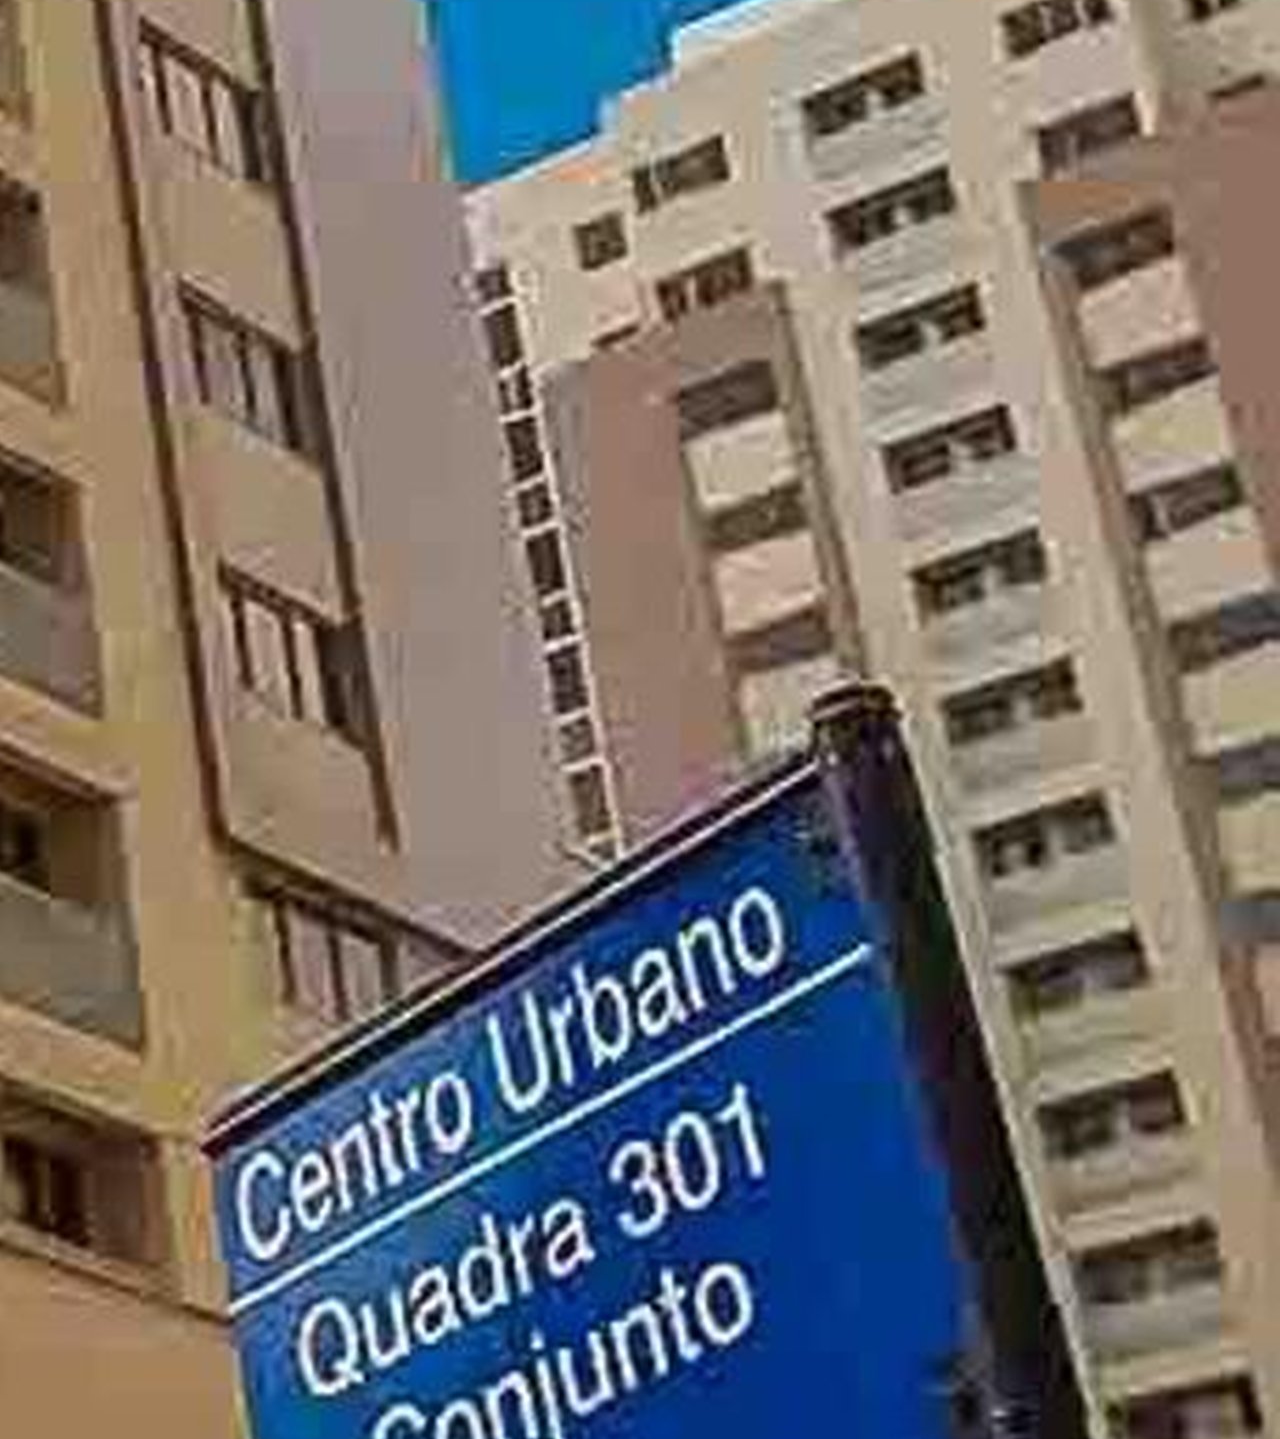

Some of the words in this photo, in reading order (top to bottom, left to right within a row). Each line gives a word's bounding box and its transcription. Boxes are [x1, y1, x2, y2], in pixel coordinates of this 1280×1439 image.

[235, 1071, 474, 1262] Centro
[486, 886, 785, 1114] Urbano
[296, 1199, 596, 1397] Quadra
[609, 1083, 765, 1238] 301
